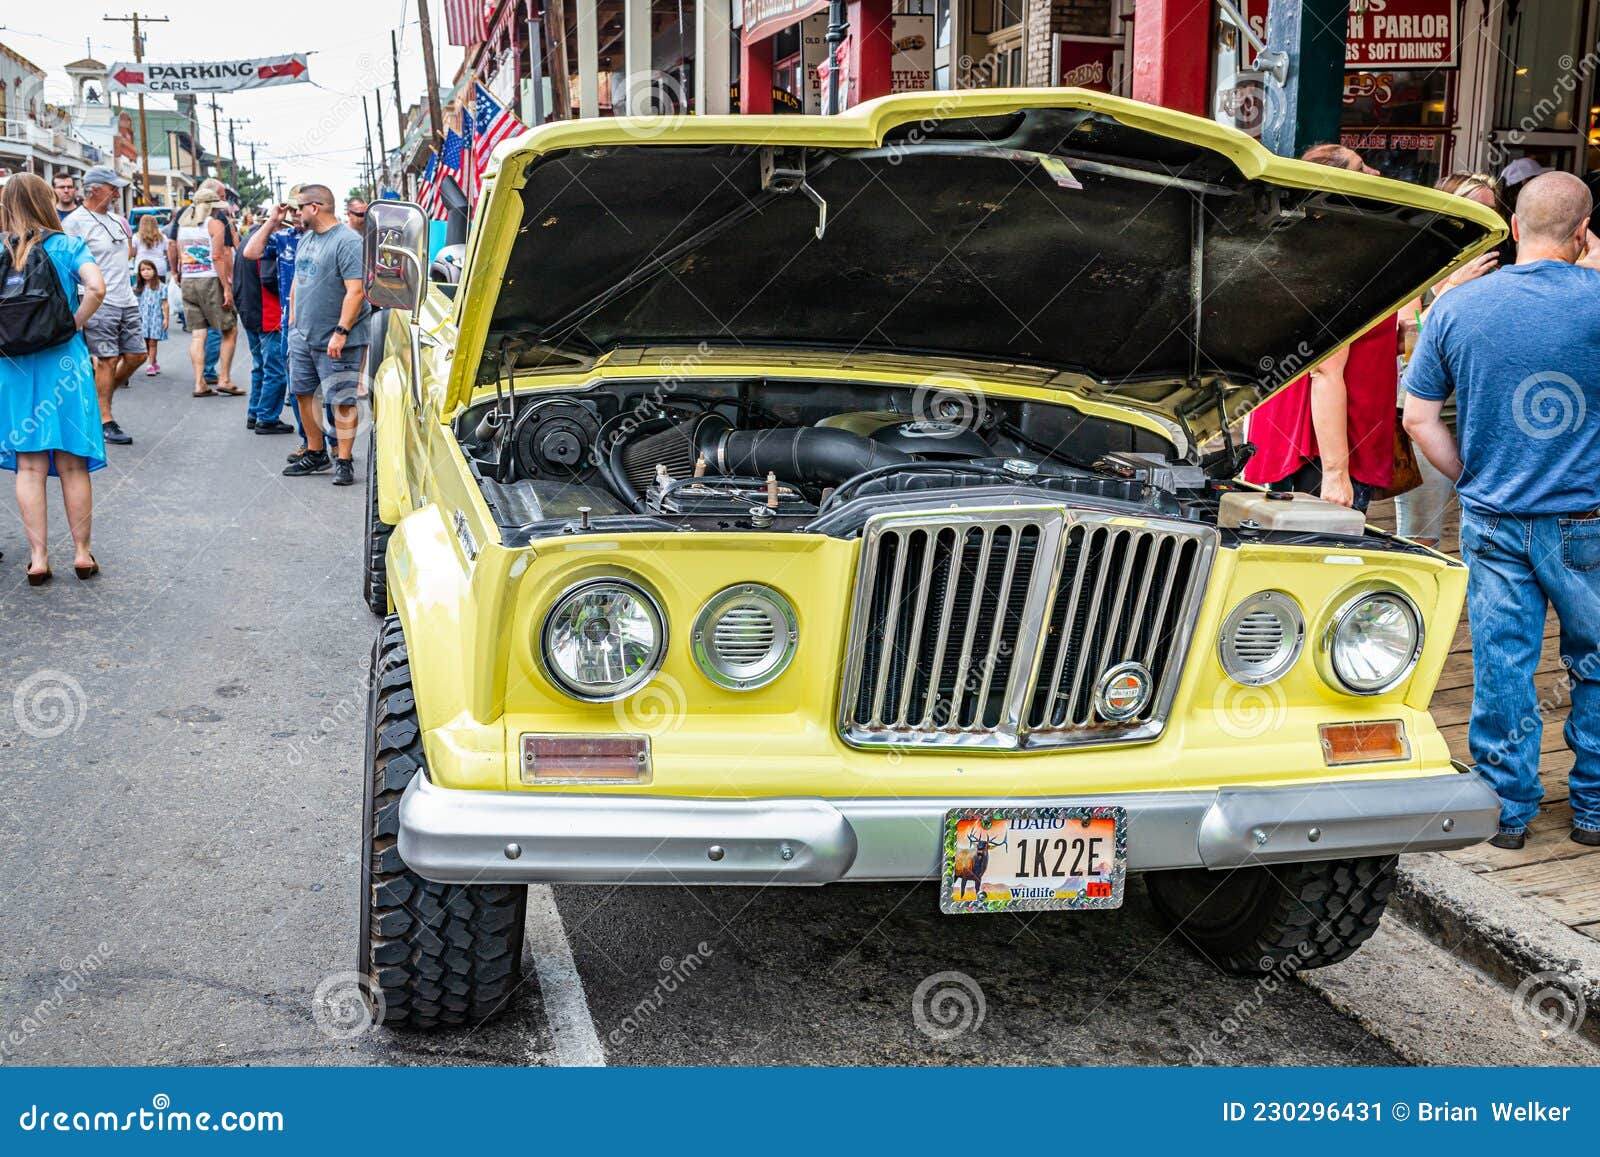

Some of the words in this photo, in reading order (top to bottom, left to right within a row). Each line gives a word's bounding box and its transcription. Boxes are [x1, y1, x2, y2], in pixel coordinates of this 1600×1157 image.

[1374, 15, 1448, 38] PARLOR
[1368, 43, 1397, 60] SOFT
[149, 62, 253, 80] PARKING
[891, 71, 930, 80] ITTLES
[150, 81, 190, 91] CARS
[891, 80, 925, 89] FFLES
[1341, 134, 1386, 149] MADE
[1391, 133, 1434, 150] FUDGE
[1008, 819, 1066, 830] IDAHO
[1015, 838, 1104, 878] 1K22E
[1010, 887, 1055, 899] Wildlife
